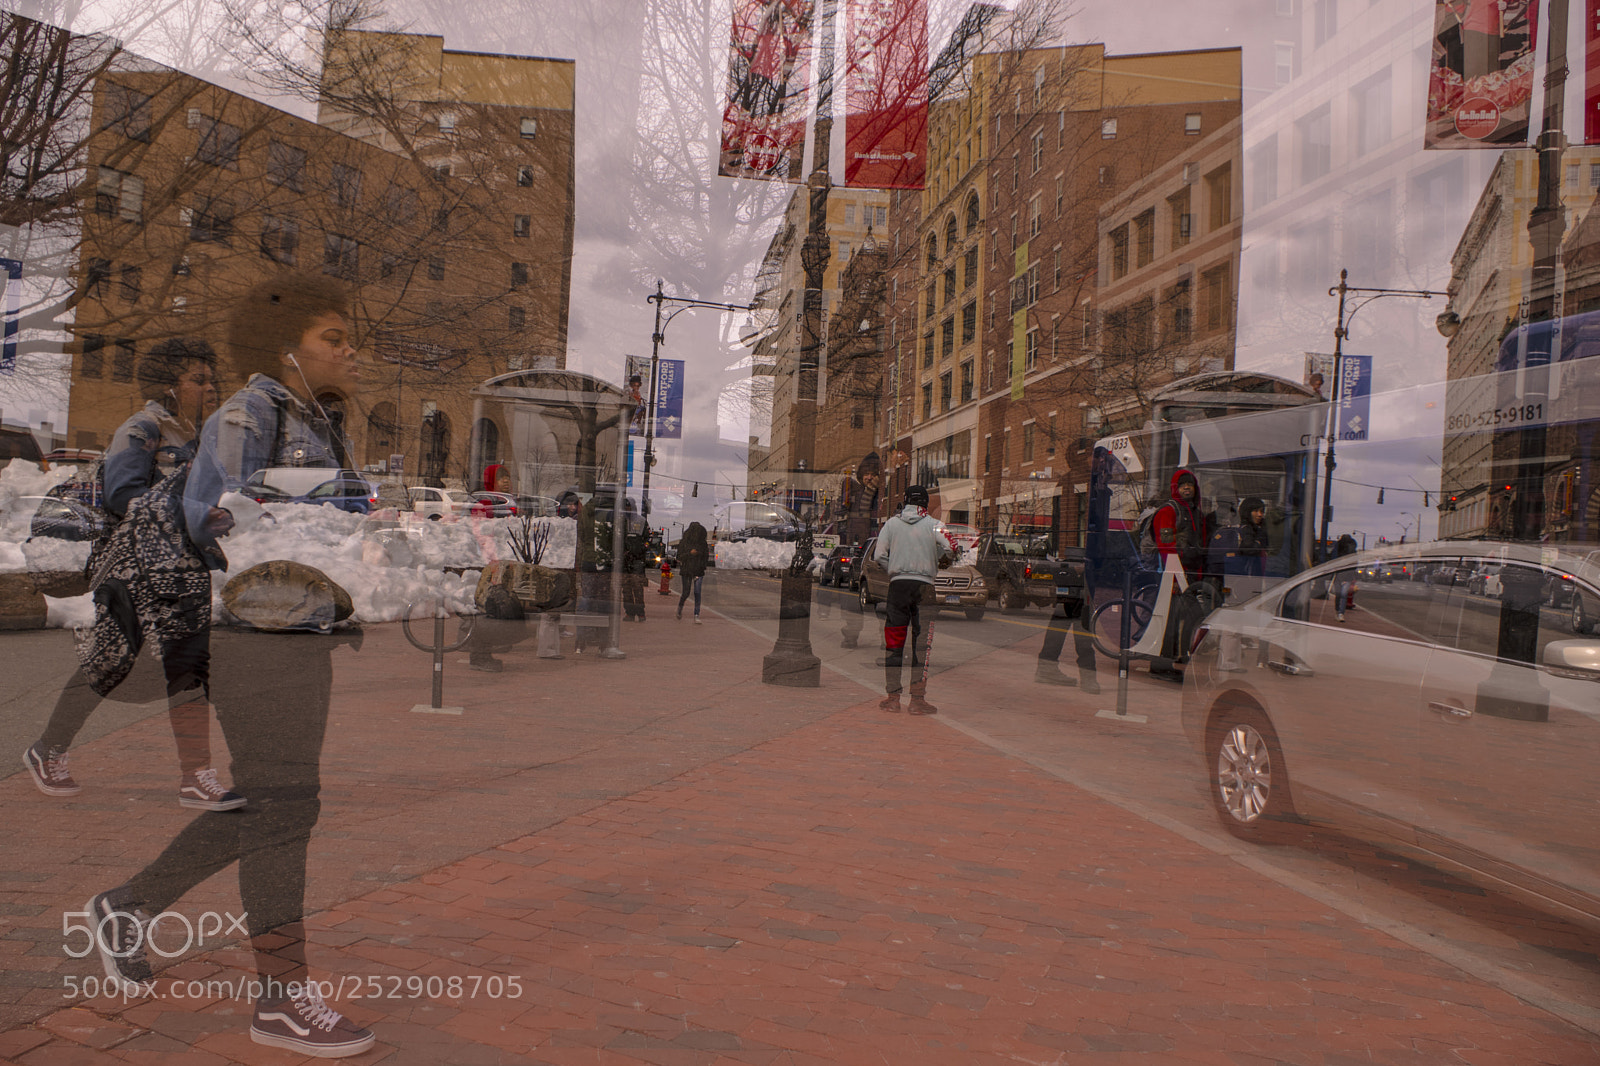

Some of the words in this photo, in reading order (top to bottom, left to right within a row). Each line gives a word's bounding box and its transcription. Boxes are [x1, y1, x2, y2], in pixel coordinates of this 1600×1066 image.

[795, 312, 803, 346] BUS
[819, 308, 828, 352] STOP
[1520, 295, 1530, 333] BUS
[1551, 288, 1562, 339] STOP
[1354, 357, 1361, 365] IT
[659, 361, 669, 409] HARTFORD
[1343, 357, 1354, 409] HARTFORD
[1112, 437, 1129, 451] 1833
